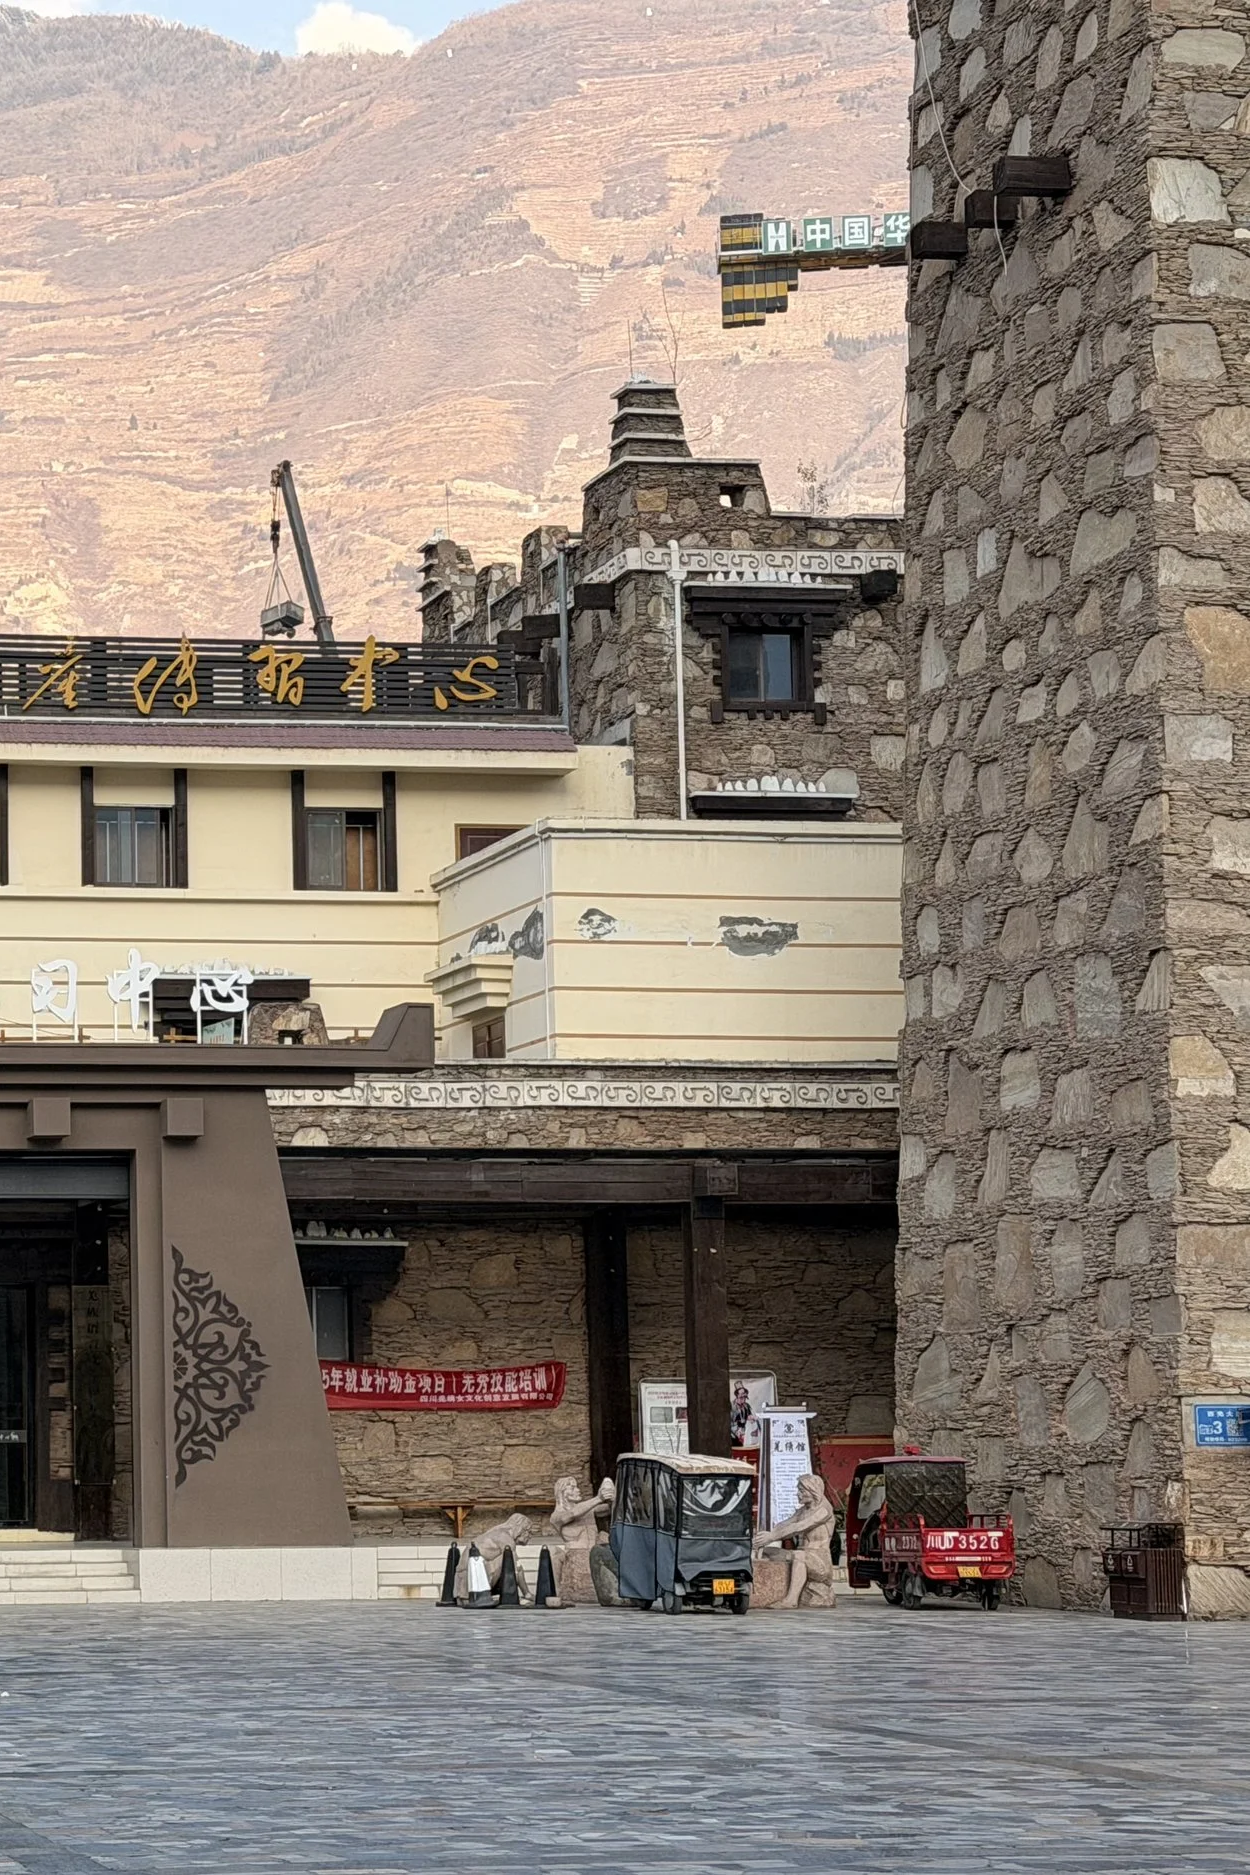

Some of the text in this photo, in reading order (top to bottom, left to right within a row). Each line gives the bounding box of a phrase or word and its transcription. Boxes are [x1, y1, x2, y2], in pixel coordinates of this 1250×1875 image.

[806, 214, 910, 248] 中国华
[1213, 1421, 1222, 1434] 3
